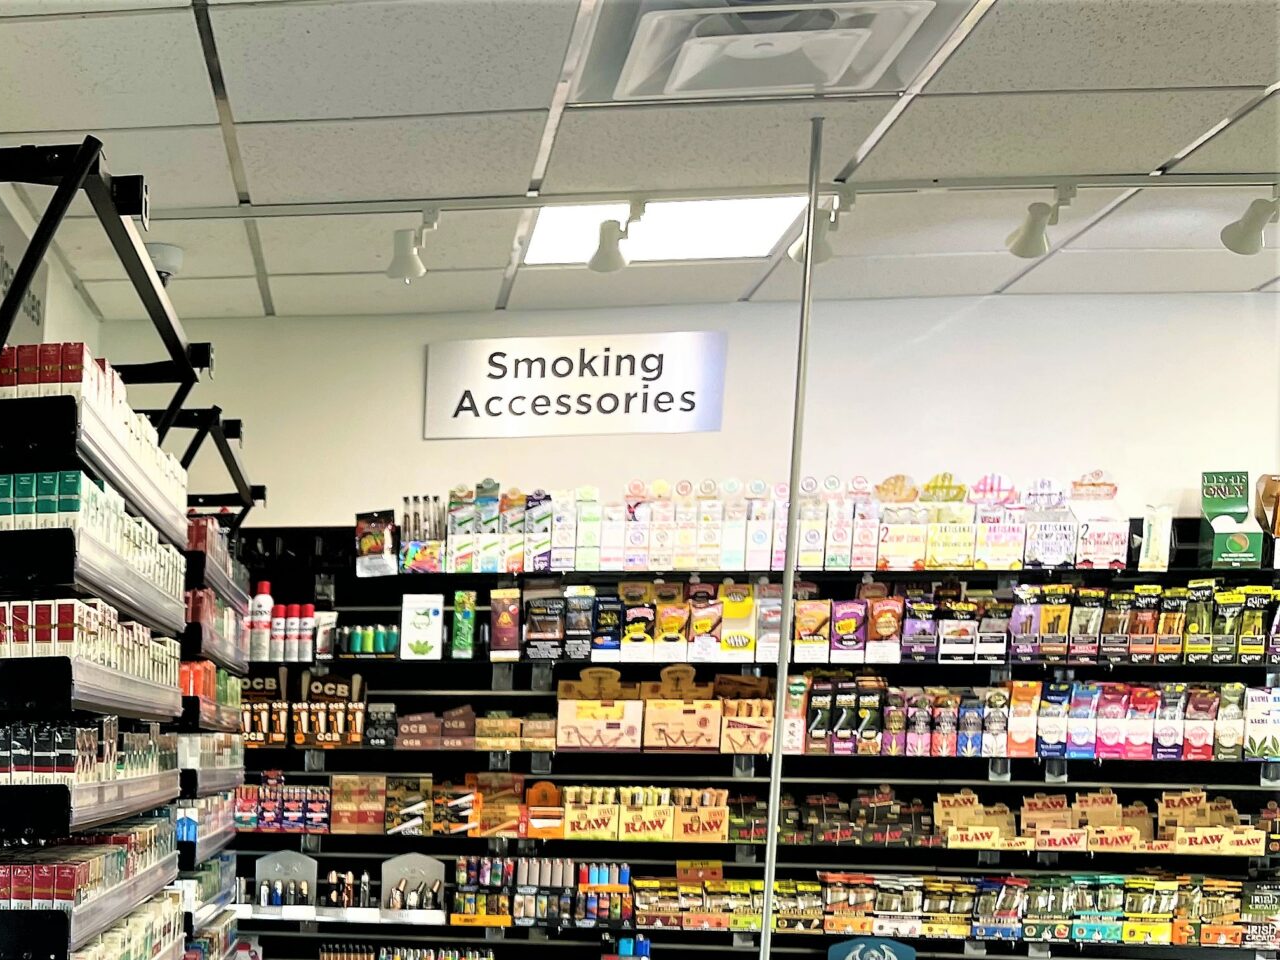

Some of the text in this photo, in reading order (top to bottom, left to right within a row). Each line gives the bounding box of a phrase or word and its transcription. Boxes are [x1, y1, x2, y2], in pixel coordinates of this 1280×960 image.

[487, 348, 665, 381] Smoking
[453, 384, 697, 418] Accessories
[241, 678, 277, 690] OCB
[310, 681, 349, 697] OCB
[401, 724, 427, 733] OCB
[444, 721, 465, 729] OCB
[242, 733, 264, 741] OCB
[317, 733, 341, 741] OCB
[942, 798, 975, 808] RAW
[1027, 800, 1065, 811] RAW
[1079, 796, 1114, 807] RAW
[1165, 796, 1202, 808] RAW
[960, 831, 993, 842] RAW
[1048, 835, 1081, 847] RAW
[1099, 834, 1132, 846] RAW
[1188, 834, 1224, 846] RAW
[1236, 838, 1262, 846] RAW
[1007, 840, 1027, 848] RAW
